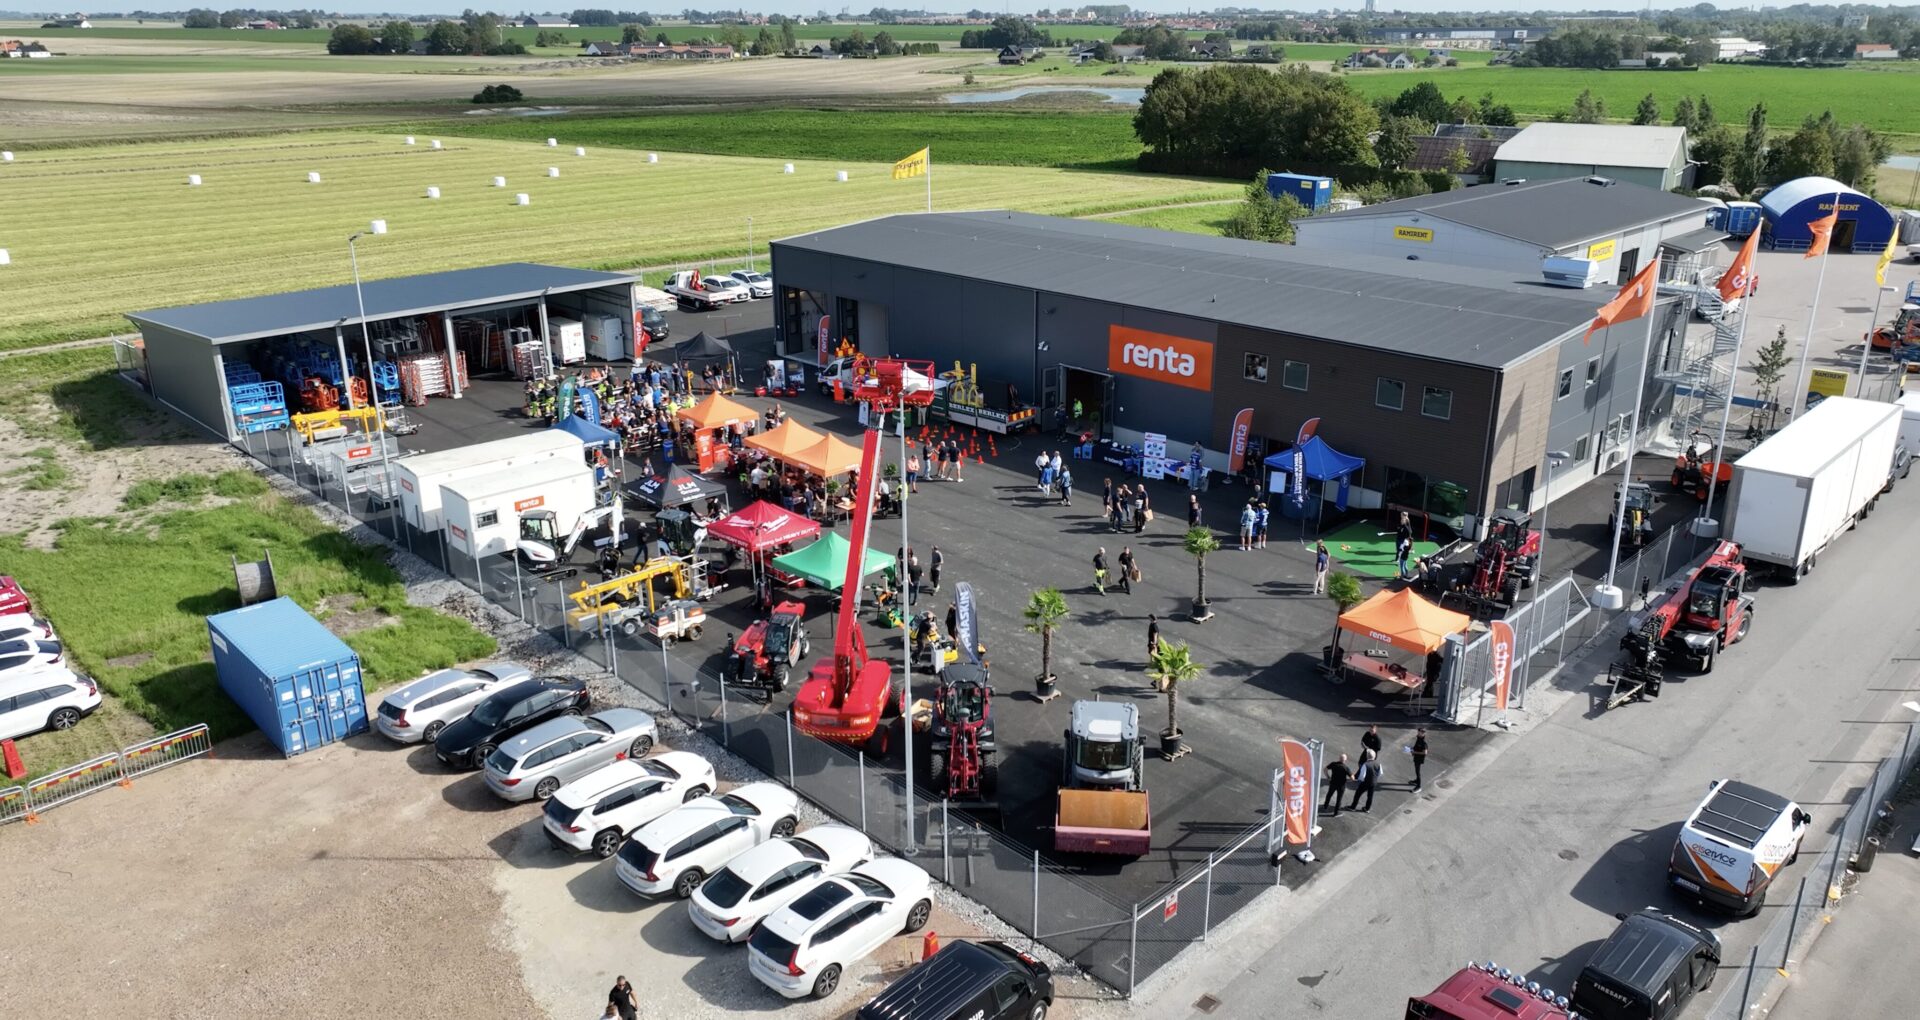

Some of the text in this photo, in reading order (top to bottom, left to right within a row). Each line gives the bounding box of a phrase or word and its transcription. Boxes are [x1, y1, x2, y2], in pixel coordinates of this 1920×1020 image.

[1817, 203, 1861, 212] RAMRENT
[1398, 229, 1429, 239] RAMIRENT
[821, 328, 829, 353] renta
[1123, 342, 1195, 377] renta
[949, 402, 975, 413] BERLEX
[978, 408, 1007, 420] BERLEX
[1235, 424, 1248, 456] renta
[644, 479, 661, 490] JLM
[677, 481, 698, 492] JLM
[783, 531, 800, 540] HEAVY
[800, 526, 816, 536] DUTY
[1369, 630, 1392, 643] renta
[1593, 982, 1628, 1004] FIRESAFE
